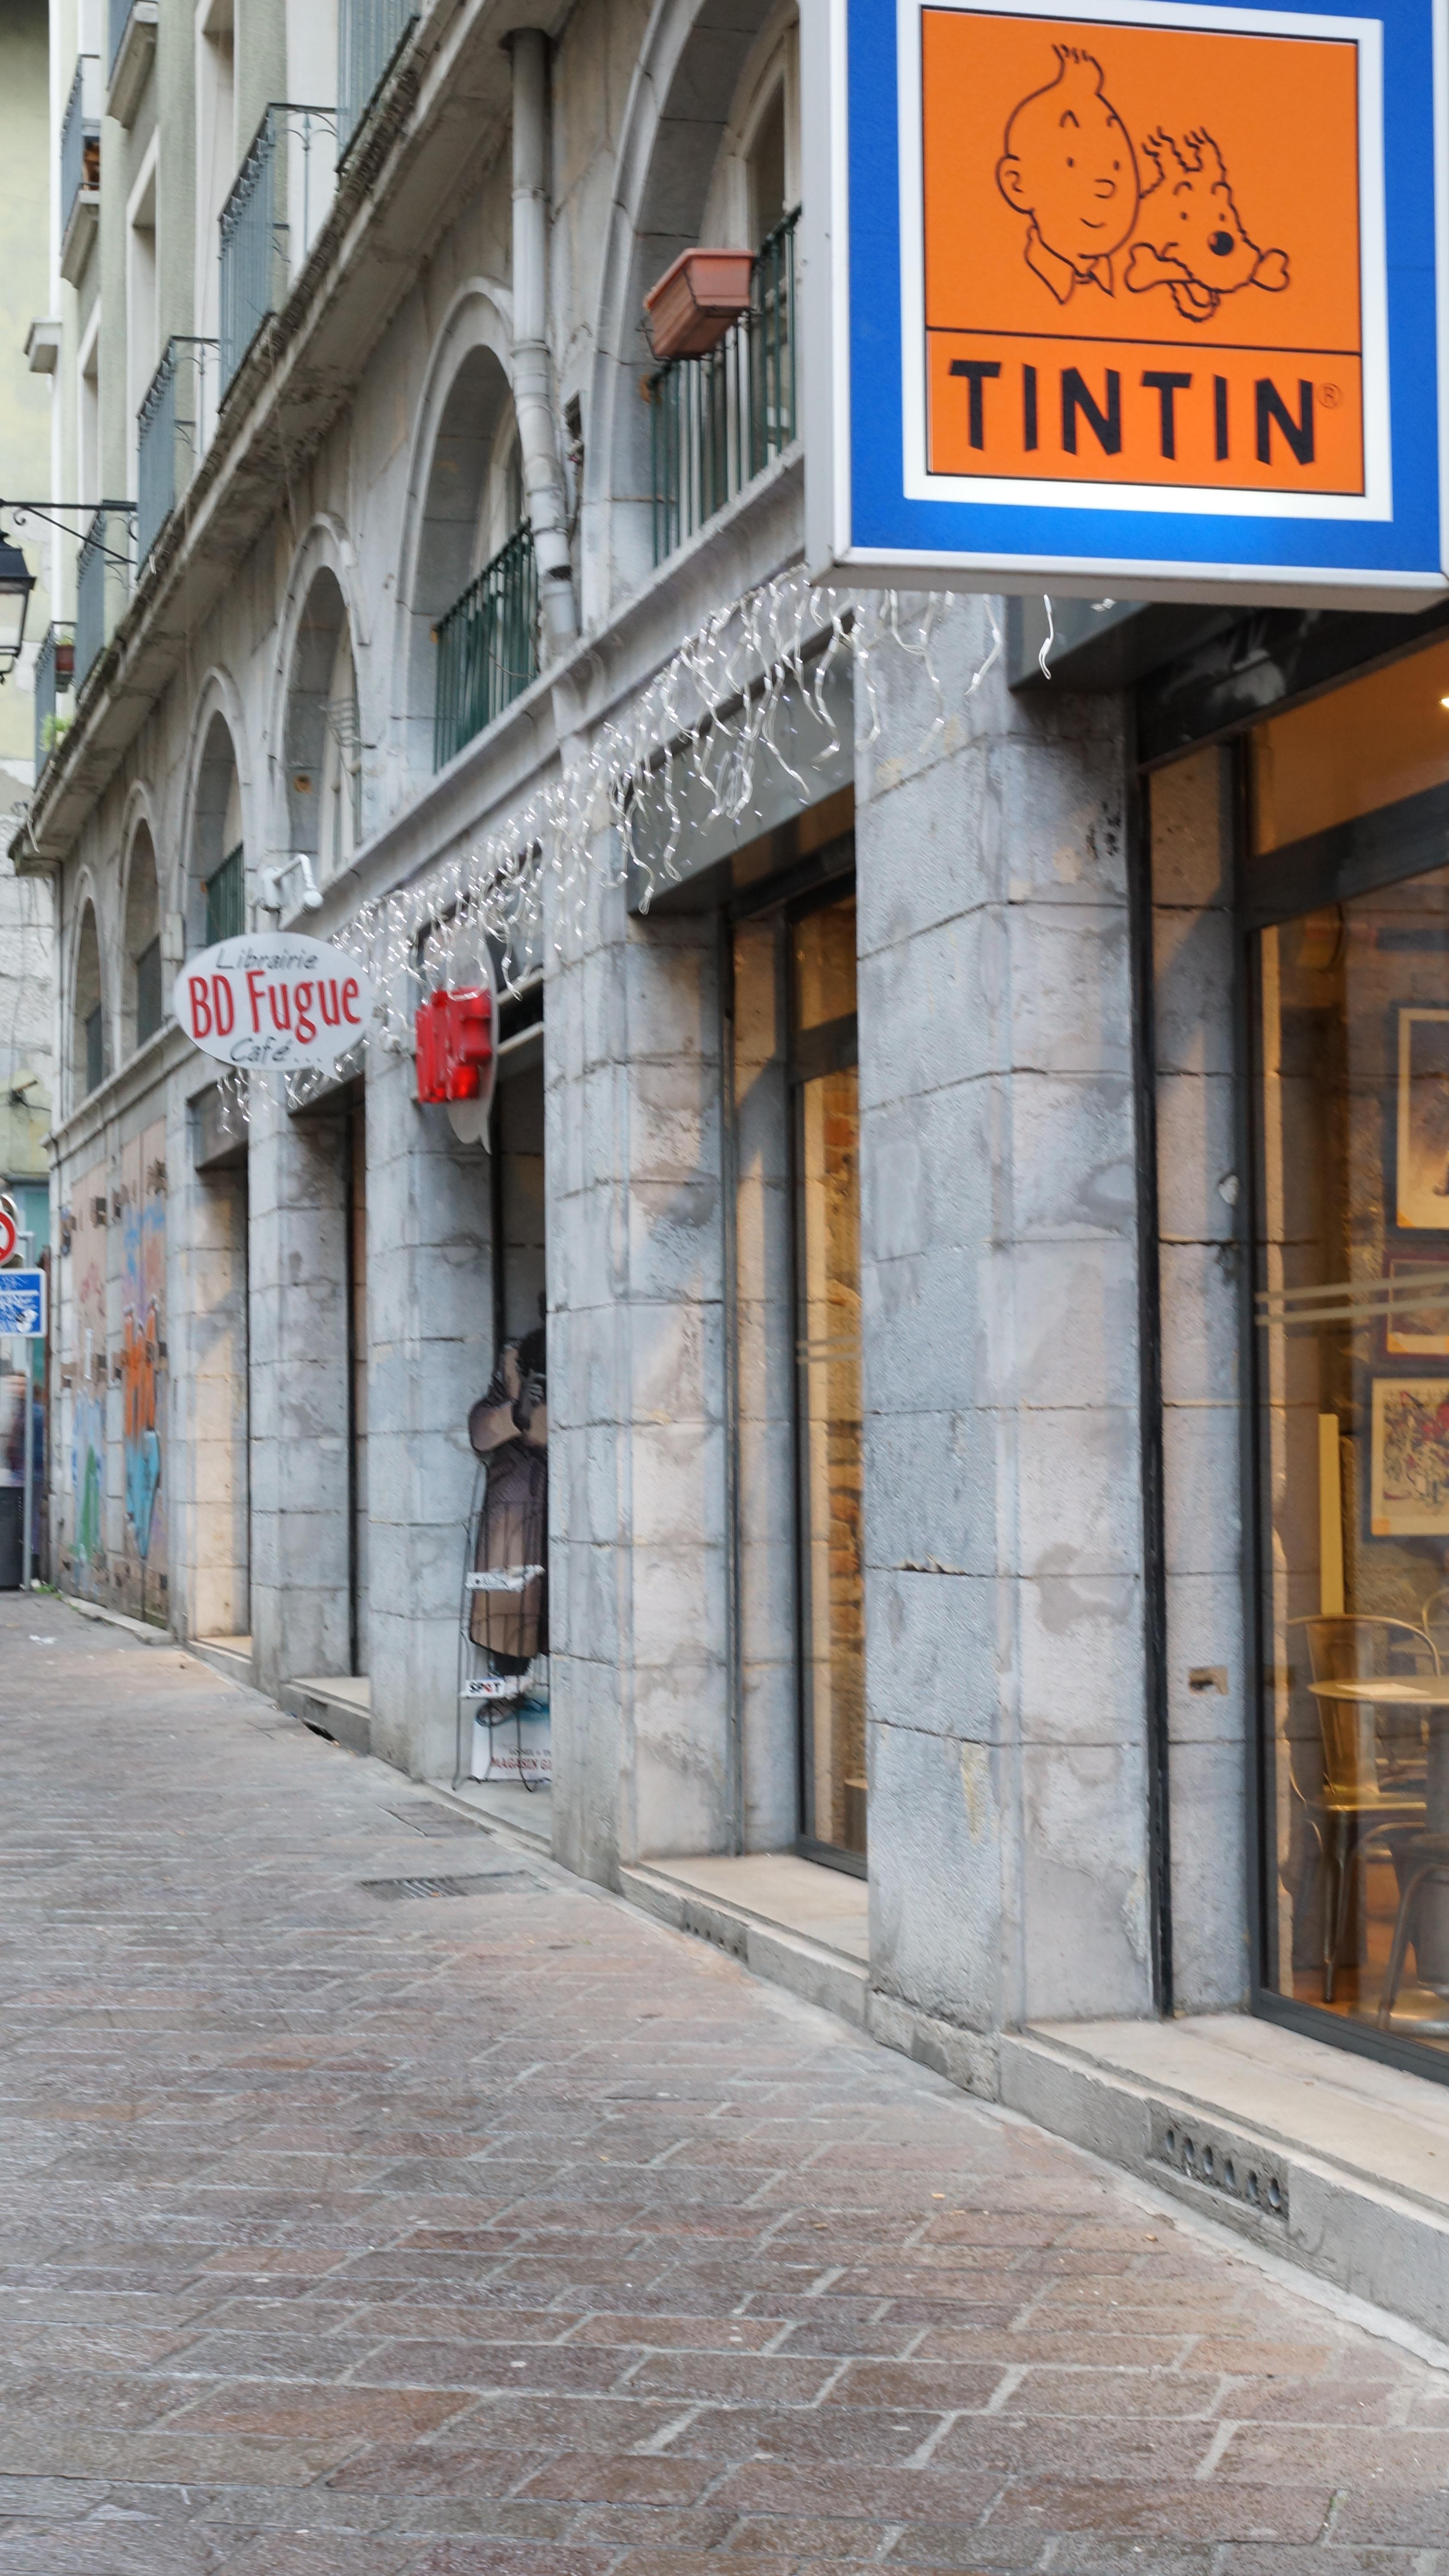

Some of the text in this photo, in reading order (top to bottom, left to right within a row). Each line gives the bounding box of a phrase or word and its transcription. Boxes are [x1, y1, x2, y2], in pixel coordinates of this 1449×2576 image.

[216, 947, 319, 970] Librairie
[188, 969, 362, 1044] BD Fugue
